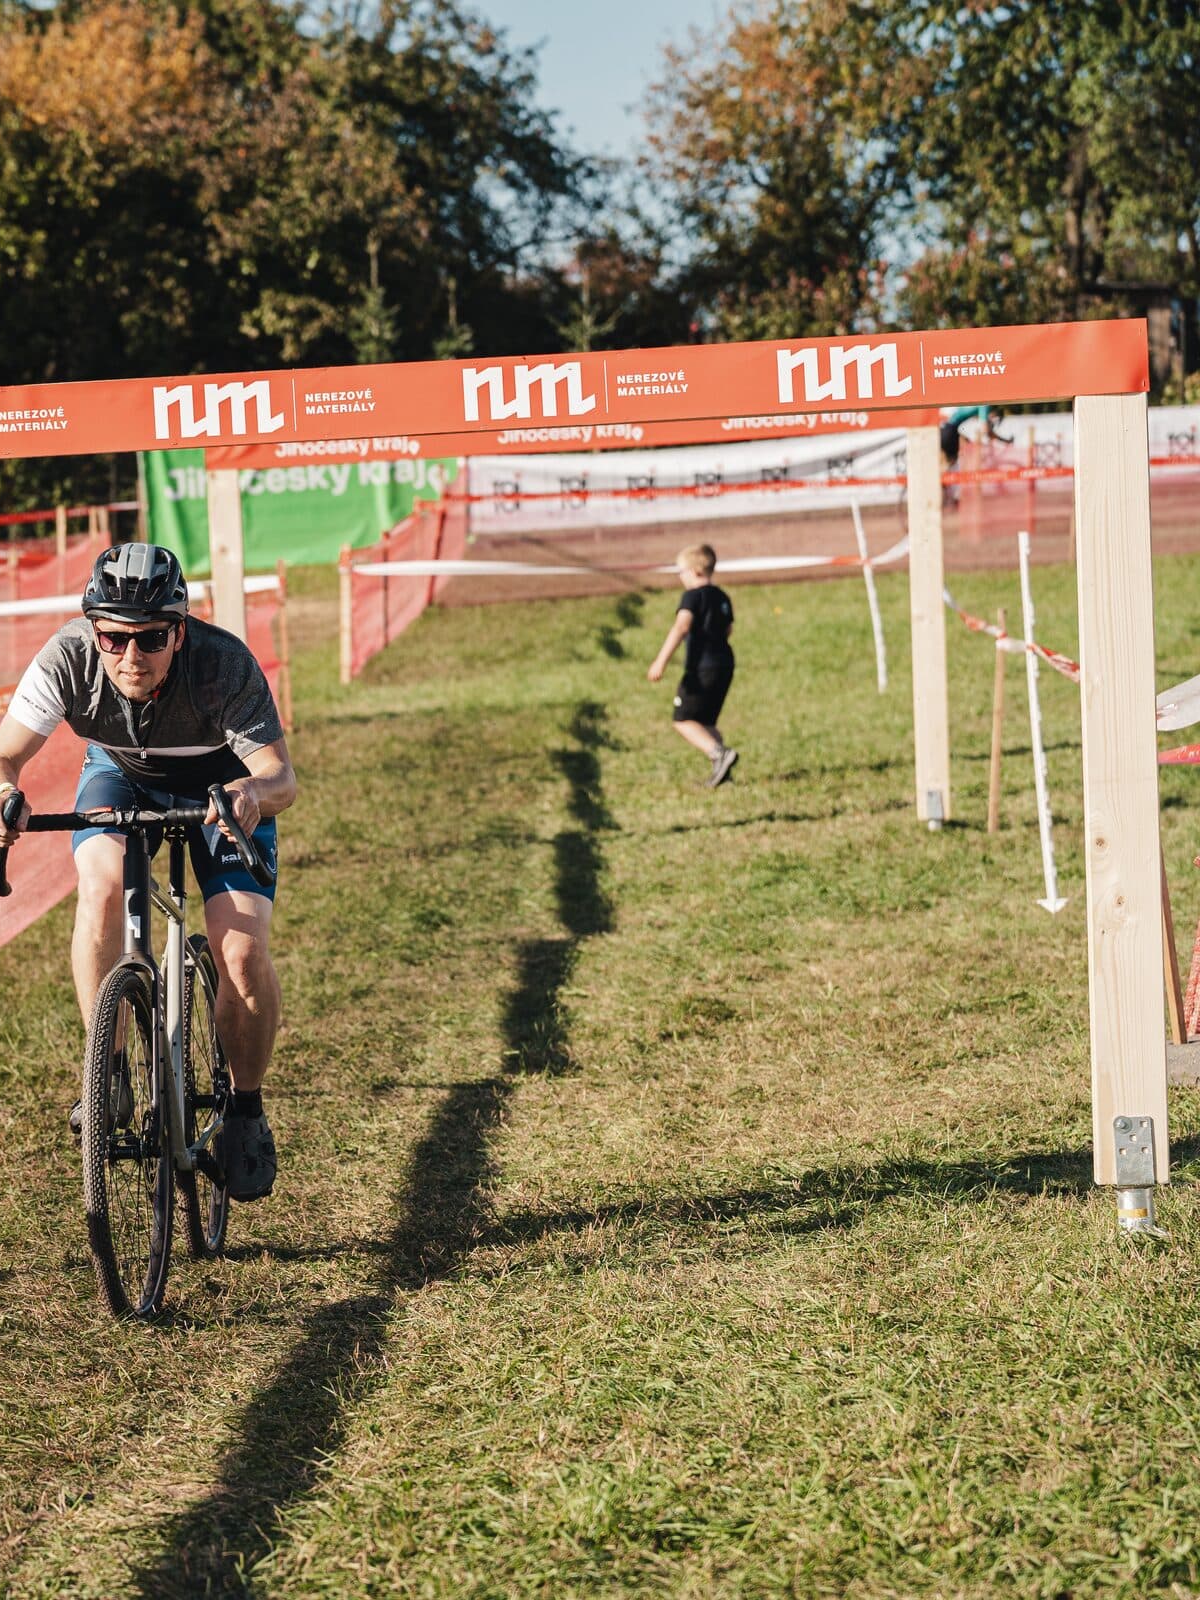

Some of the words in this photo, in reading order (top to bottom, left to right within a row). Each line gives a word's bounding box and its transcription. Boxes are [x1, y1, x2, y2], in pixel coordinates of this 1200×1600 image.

[934, 351, 1003, 365] NEREZOVÉ
[617, 370, 685, 384] NEREZOVÉ
[934, 365, 1006, 378] MATERIÁLY
[305, 388, 372, 402] NEREZOVÉ
[618, 384, 689, 397] MATERIÁLY
[0, 406, 65, 420] NEREZOVÉ
[306, 402, 376, 415] MATERIÁLY
[0, 419, 68, 433] MATERIÁLY
